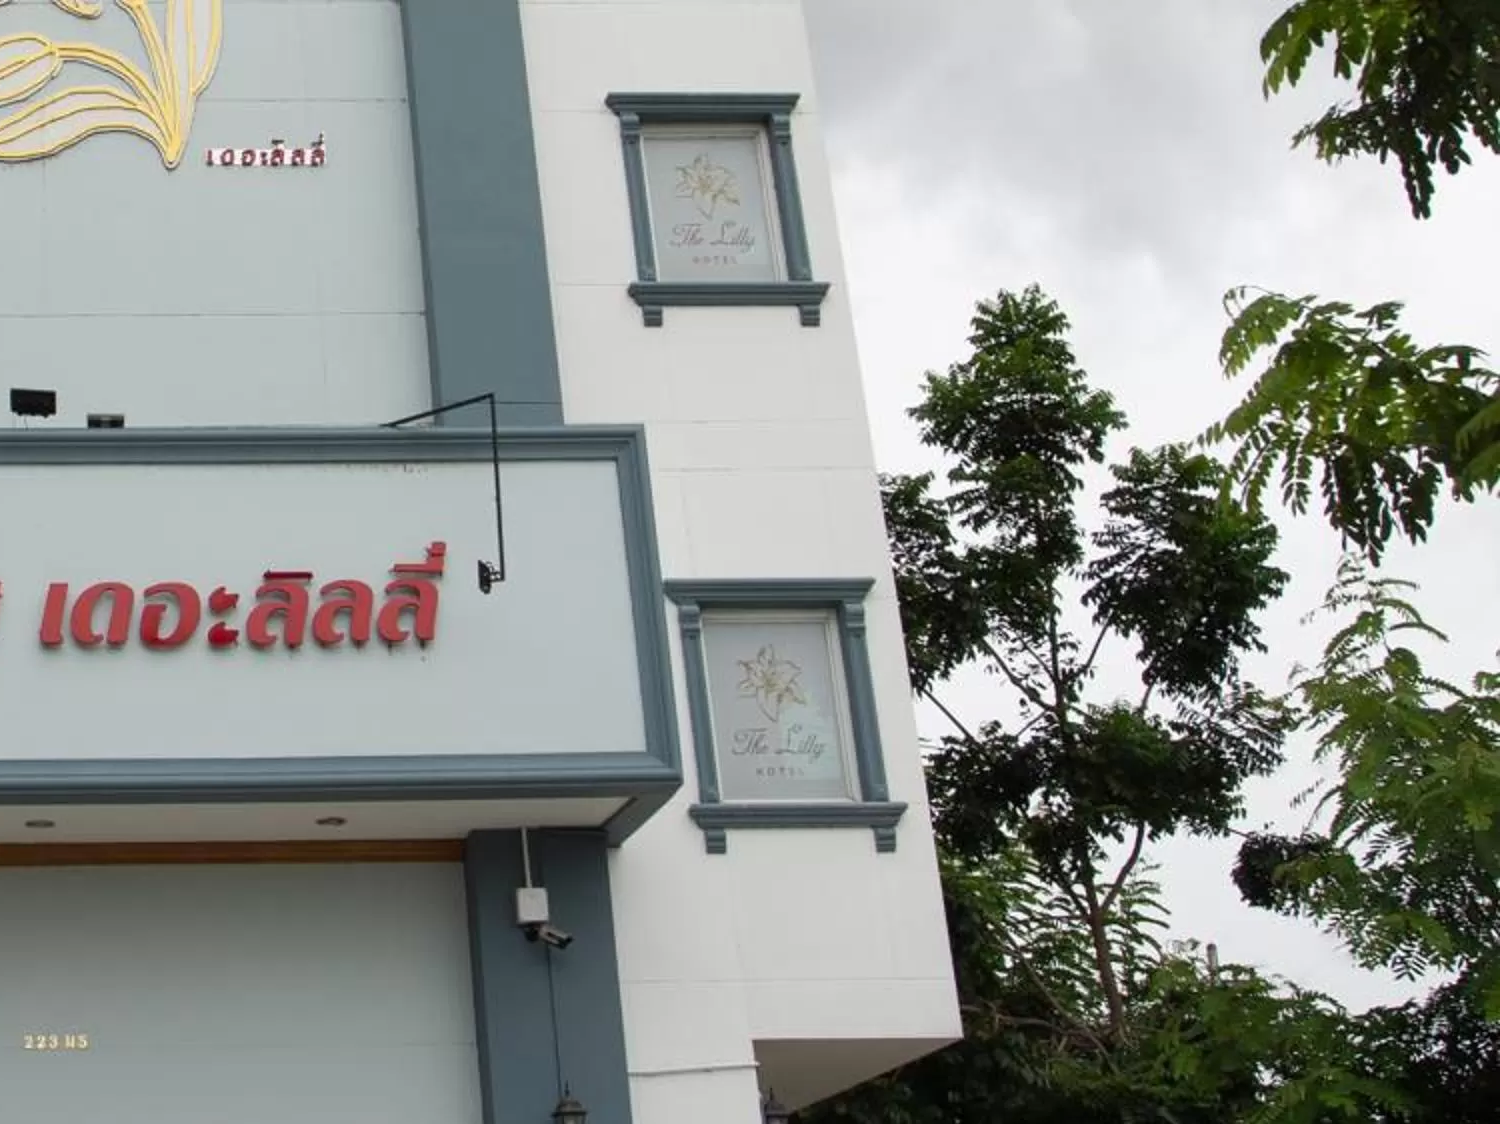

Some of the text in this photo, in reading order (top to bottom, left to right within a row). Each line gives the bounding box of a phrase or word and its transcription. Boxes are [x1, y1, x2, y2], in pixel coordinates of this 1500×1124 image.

[205, 132, 326, 168] เดอะลิลลี่
[668, 222, 705, 247] The
[39, 541, 447, 650] เดอะลิลลี่
[731, 722, 828, 765] The Lilly
